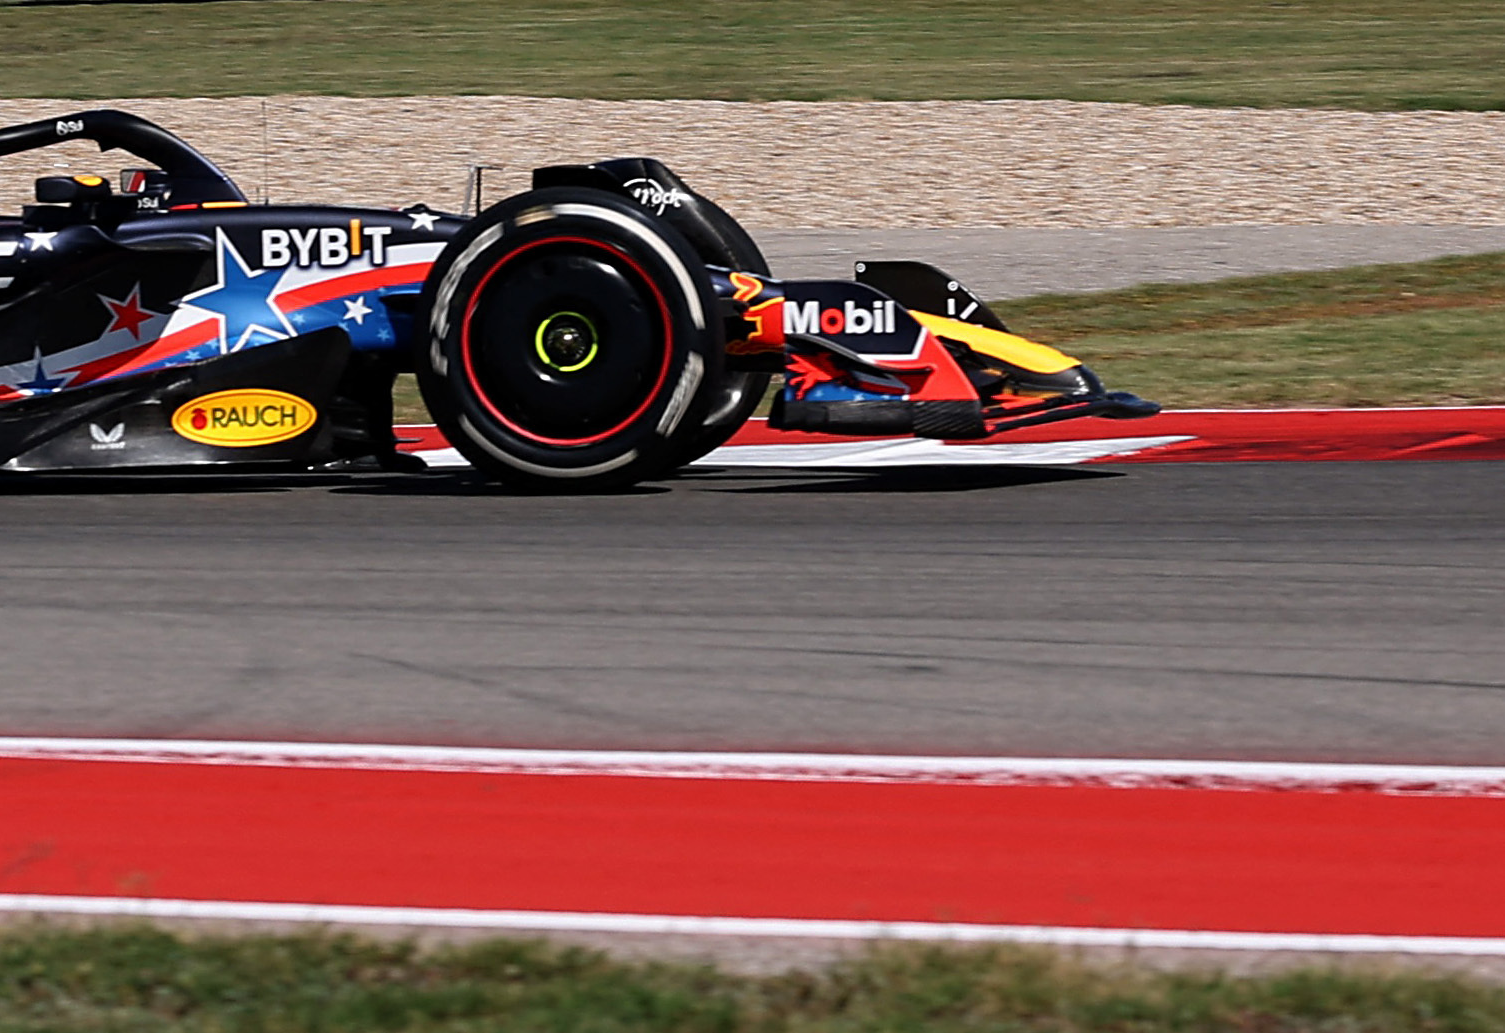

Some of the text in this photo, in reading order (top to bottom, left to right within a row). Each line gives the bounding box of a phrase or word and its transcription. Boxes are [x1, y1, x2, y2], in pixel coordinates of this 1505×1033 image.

[262, 219, 392, 267] BYBIT
[783, 299, 896, 335] Mobil
[211, 404, 298, 428] RAUCH
